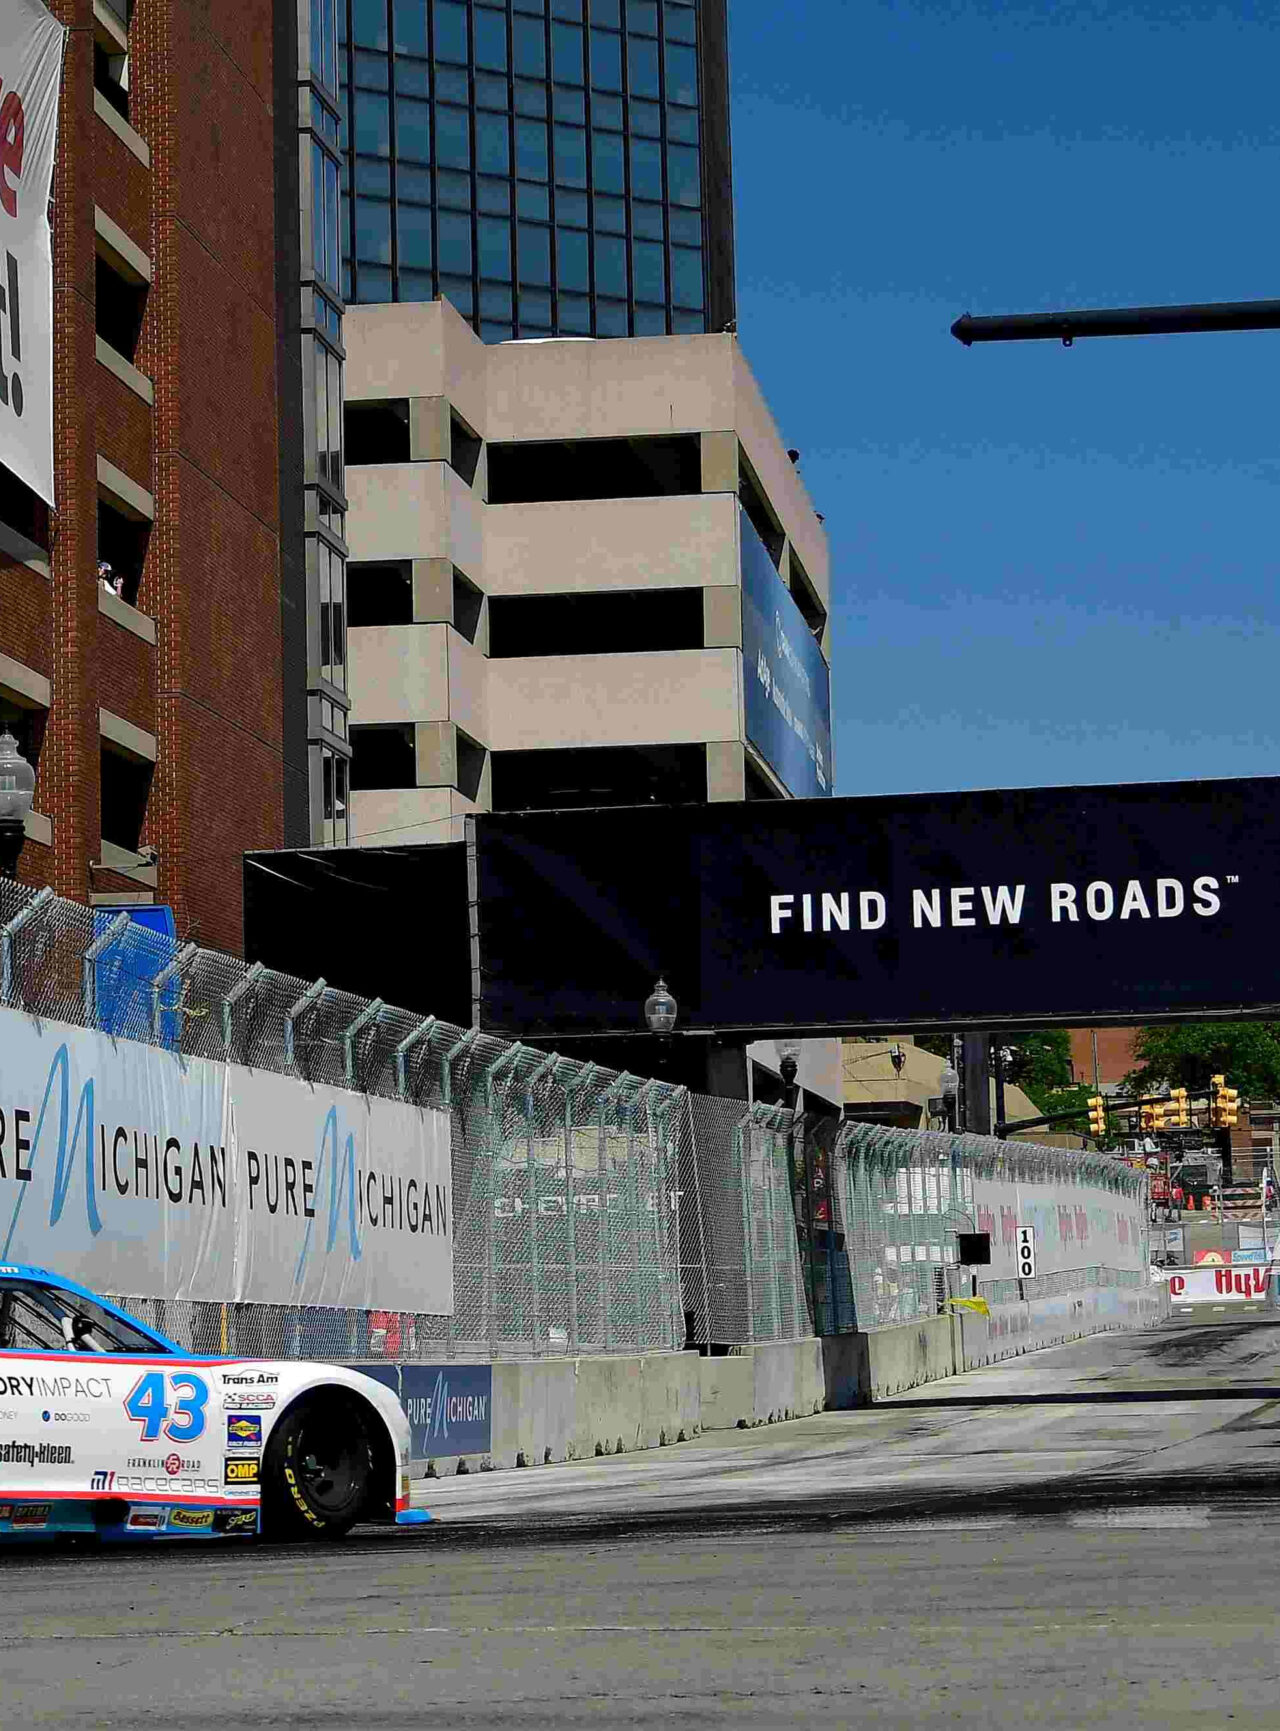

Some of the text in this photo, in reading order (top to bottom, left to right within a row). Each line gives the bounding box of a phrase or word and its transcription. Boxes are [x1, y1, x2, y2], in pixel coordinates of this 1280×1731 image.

[769, 890, 887, 934] FIND
[912, 884, 1026, 928] NEW
[3, 1042, 227, 1261] MICHIGAN
[247, 1104, 448, 1285] PURE MICHIGAN
[1020, 1229, 1032, 1276] 100
[222, 1373, 279, 1385] Trans Am
[122, 1369, 210, 1444] 43
[407, 1397, 432, 1425] PURE
[226, 1465, 258, 1478] OMP
